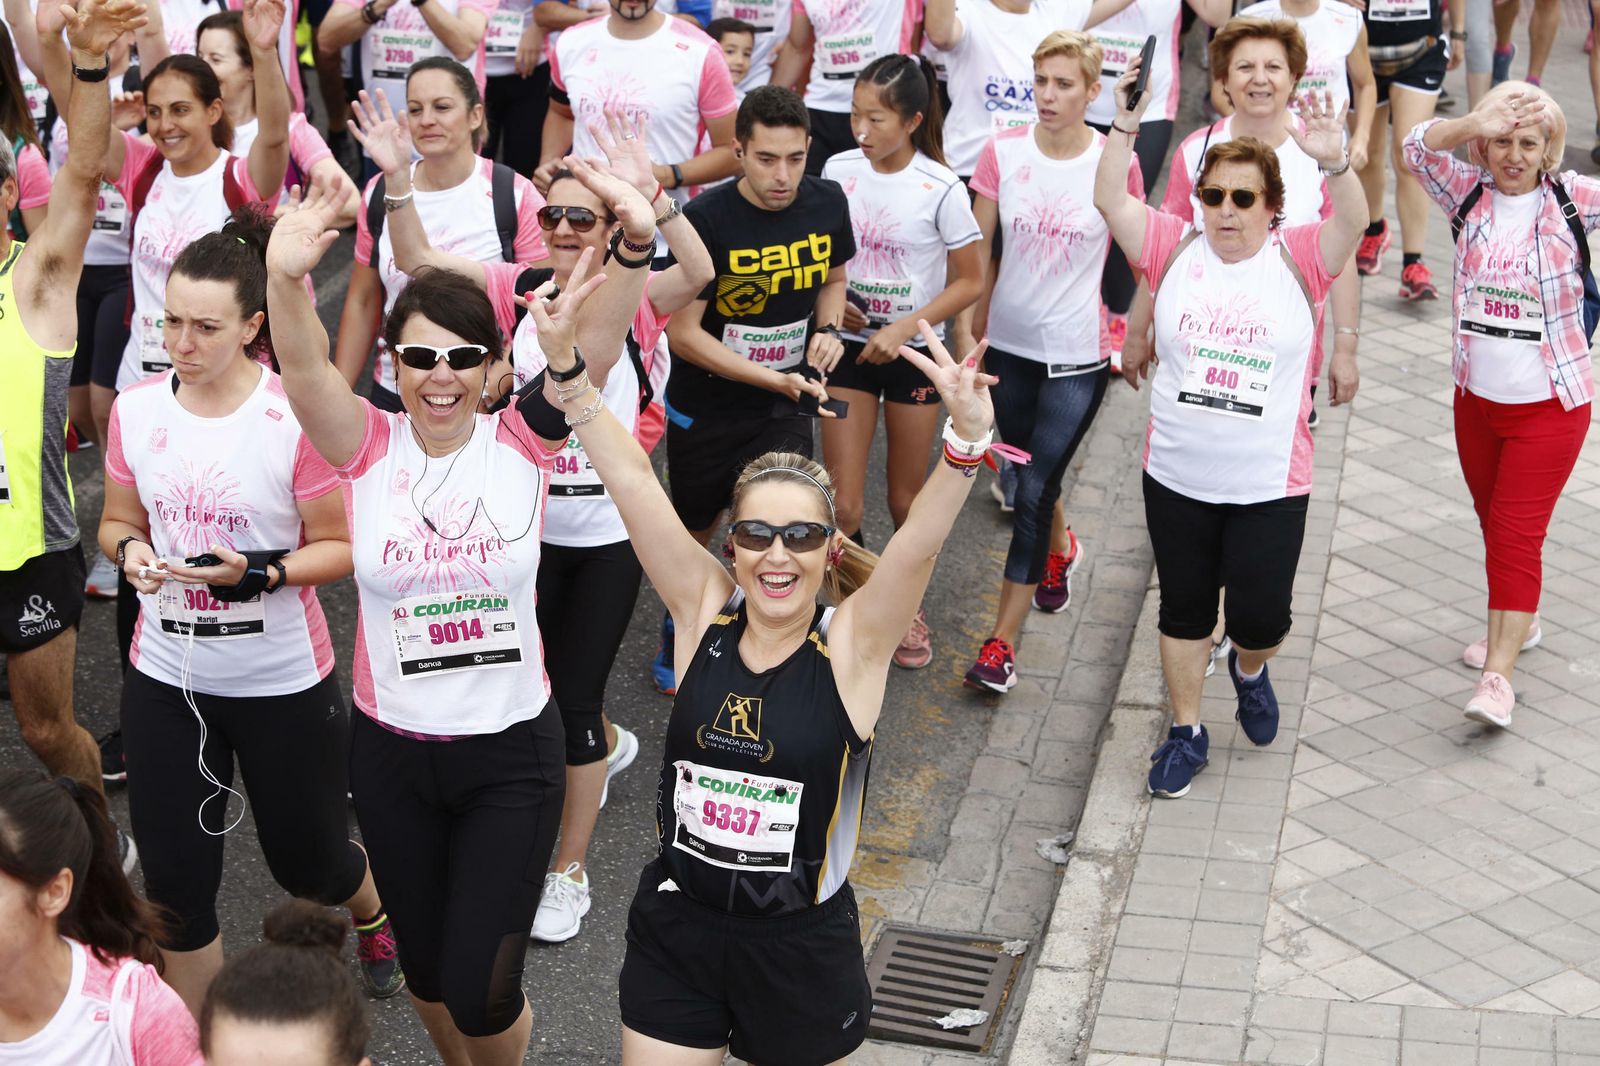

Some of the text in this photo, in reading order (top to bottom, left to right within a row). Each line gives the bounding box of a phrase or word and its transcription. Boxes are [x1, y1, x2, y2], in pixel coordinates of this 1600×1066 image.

[729, 233, 832, 275] carb
[849, 280, 912, 295] COVIRAN
[1484, 298, 1520, 320] 5813
[1178, 312, 1203, 333] Por
[742, 326, 805, 342] COVIRAN
[748, 346, 786, 362] 7940
[1198, 347, 1272, 370] COVIRAN
[1205, 366, 1239, 390] 840
[552, 455, 579, 474] 94
[155, 499, 179, 522] Por
[204, 511, 250, 533] mujer
[382, 539, 416, 565] Por
[447, 535, 504, 564] mujer
[413, 595, 509, 618] COVIRAN
[20, 618, 62, 638] Sevilla
[428, 618, 485, 645] 9014
[418, 660, 442, 669] Bankia
[704, 740, 717, 748] CLUB
[727, 746, 763, 757] ATLETISMO
[705, 732, 764, 752] GRANADA JOVEN
[697, 776, 798, 805] COVIRAN
[702, 800, 761, 836] 9337
